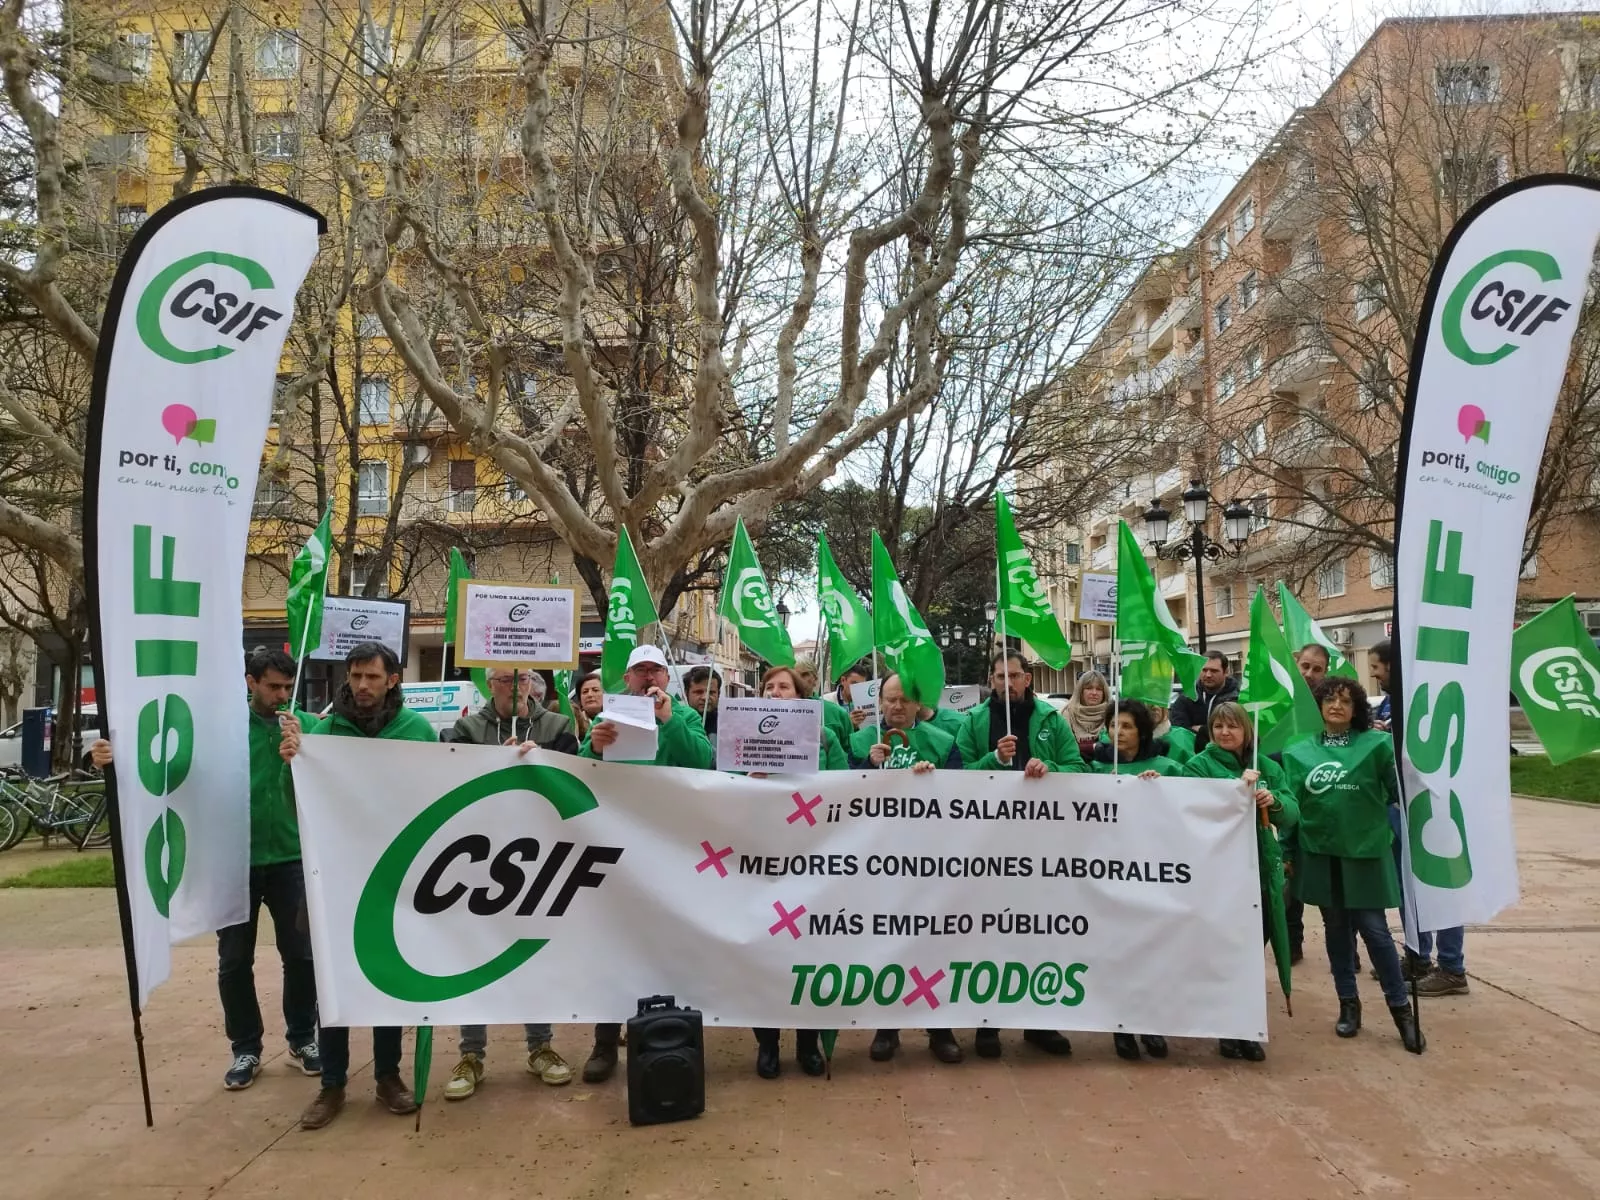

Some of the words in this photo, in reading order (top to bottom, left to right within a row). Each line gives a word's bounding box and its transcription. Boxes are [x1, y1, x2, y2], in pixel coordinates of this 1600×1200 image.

[170, 278, 283, 343] CSIF
[1469, 280, 1572, 336] CSIF
[119, 449, 159, 468] por
[163, 454, 182, 476] ti,
[1421, 450, 1454, 467] por
[1455, 452, 1470, 473] ti,
[1476, 460, 1521, 486] cntigo
[117, 475, 138, 485] en
[1405, 519, 1475, 889] CSIF
[848, 797, 944, 820] SUBIDA
[949, 799, 1065, 821] SALARIAL
[1072, 801, 1119, 823] YA!!
[412, 833, 626, 917] CSIF
[739, 854, 859, 877] MEJORES
[866, 855, 1034, 878] CONDICIONES
[1041, 857, 1193, 884] LABORALES
[808, 908, 864, 936] MÁS
[872, 914, 974, 937] EMPLEO
[981, 908, 1090, 936] PÚBLICO
